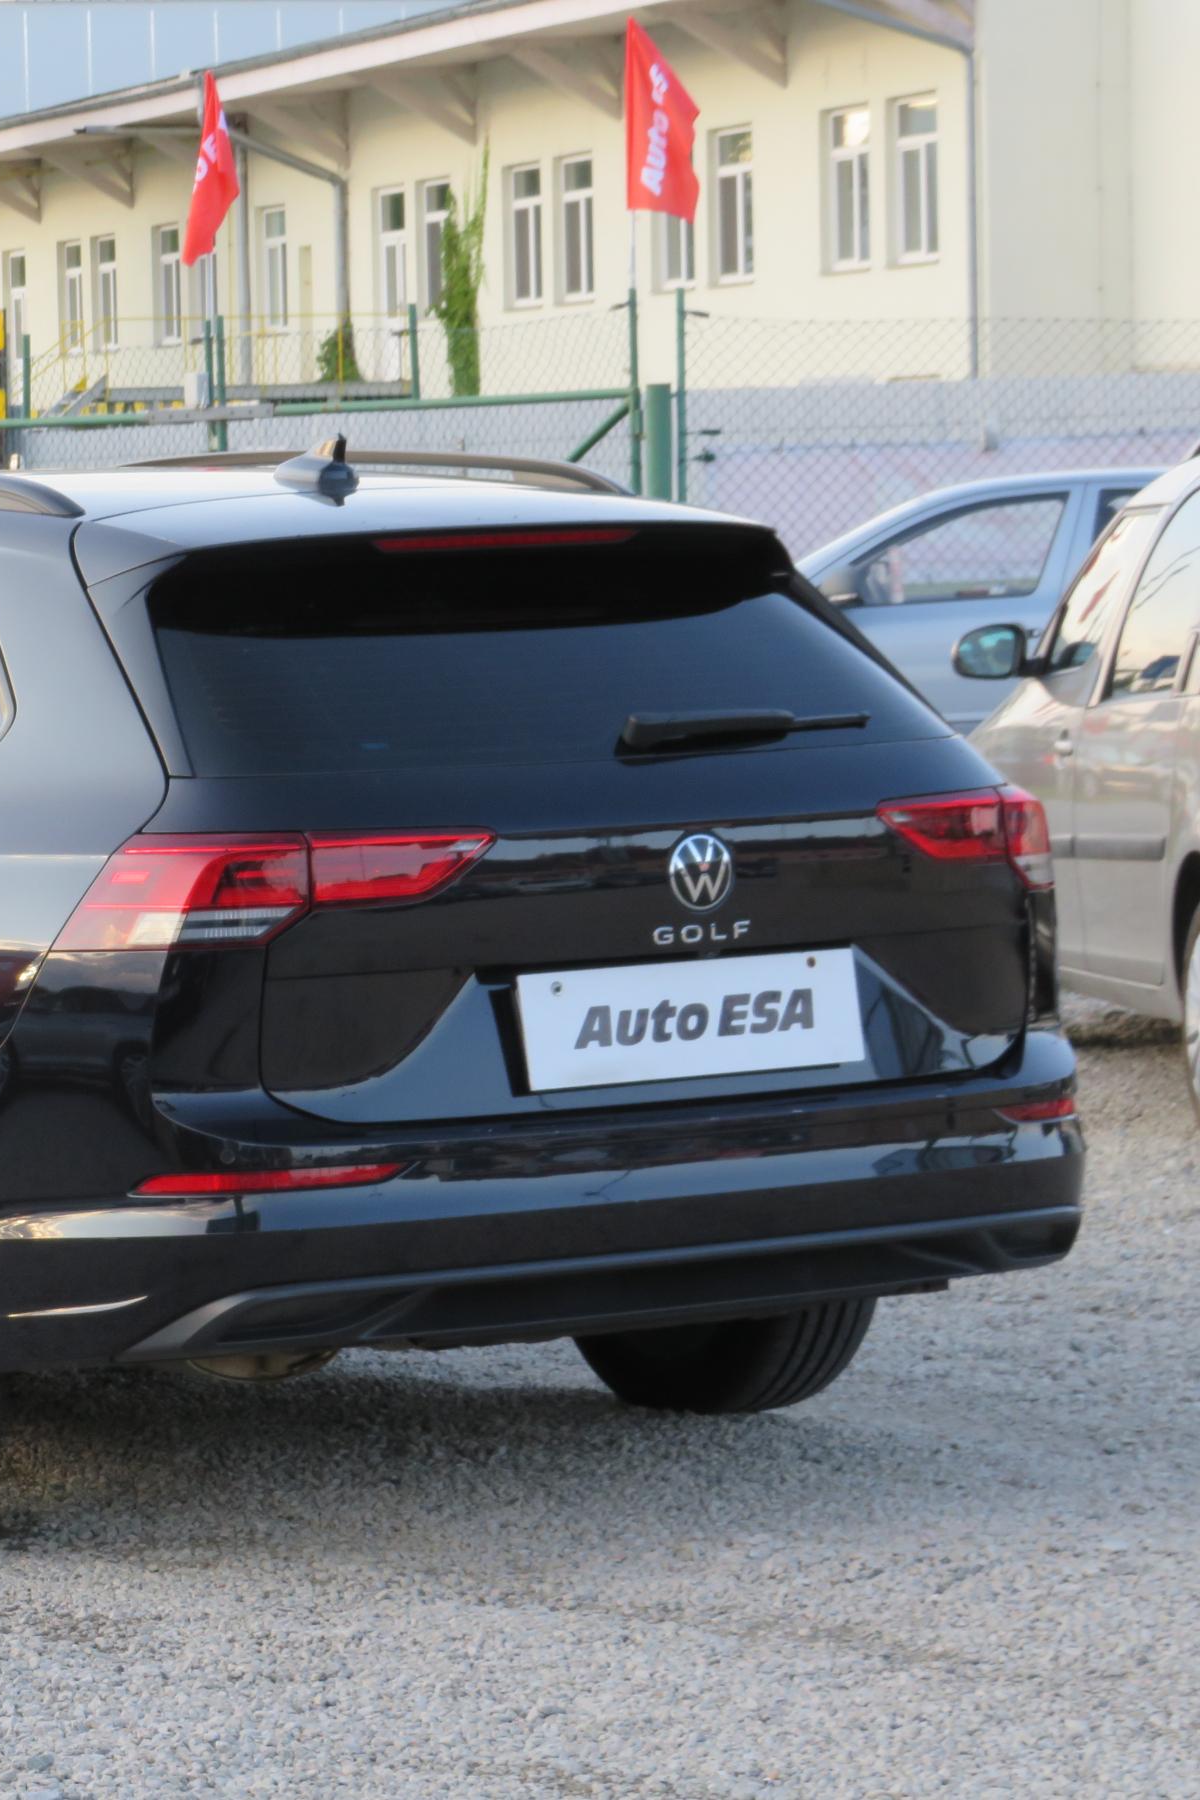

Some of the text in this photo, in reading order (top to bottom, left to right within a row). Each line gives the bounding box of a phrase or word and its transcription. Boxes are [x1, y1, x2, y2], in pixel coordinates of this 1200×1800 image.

[652, 920, 750, 945] GOLF
[574, 988, 814, 1050] Auto ESA
